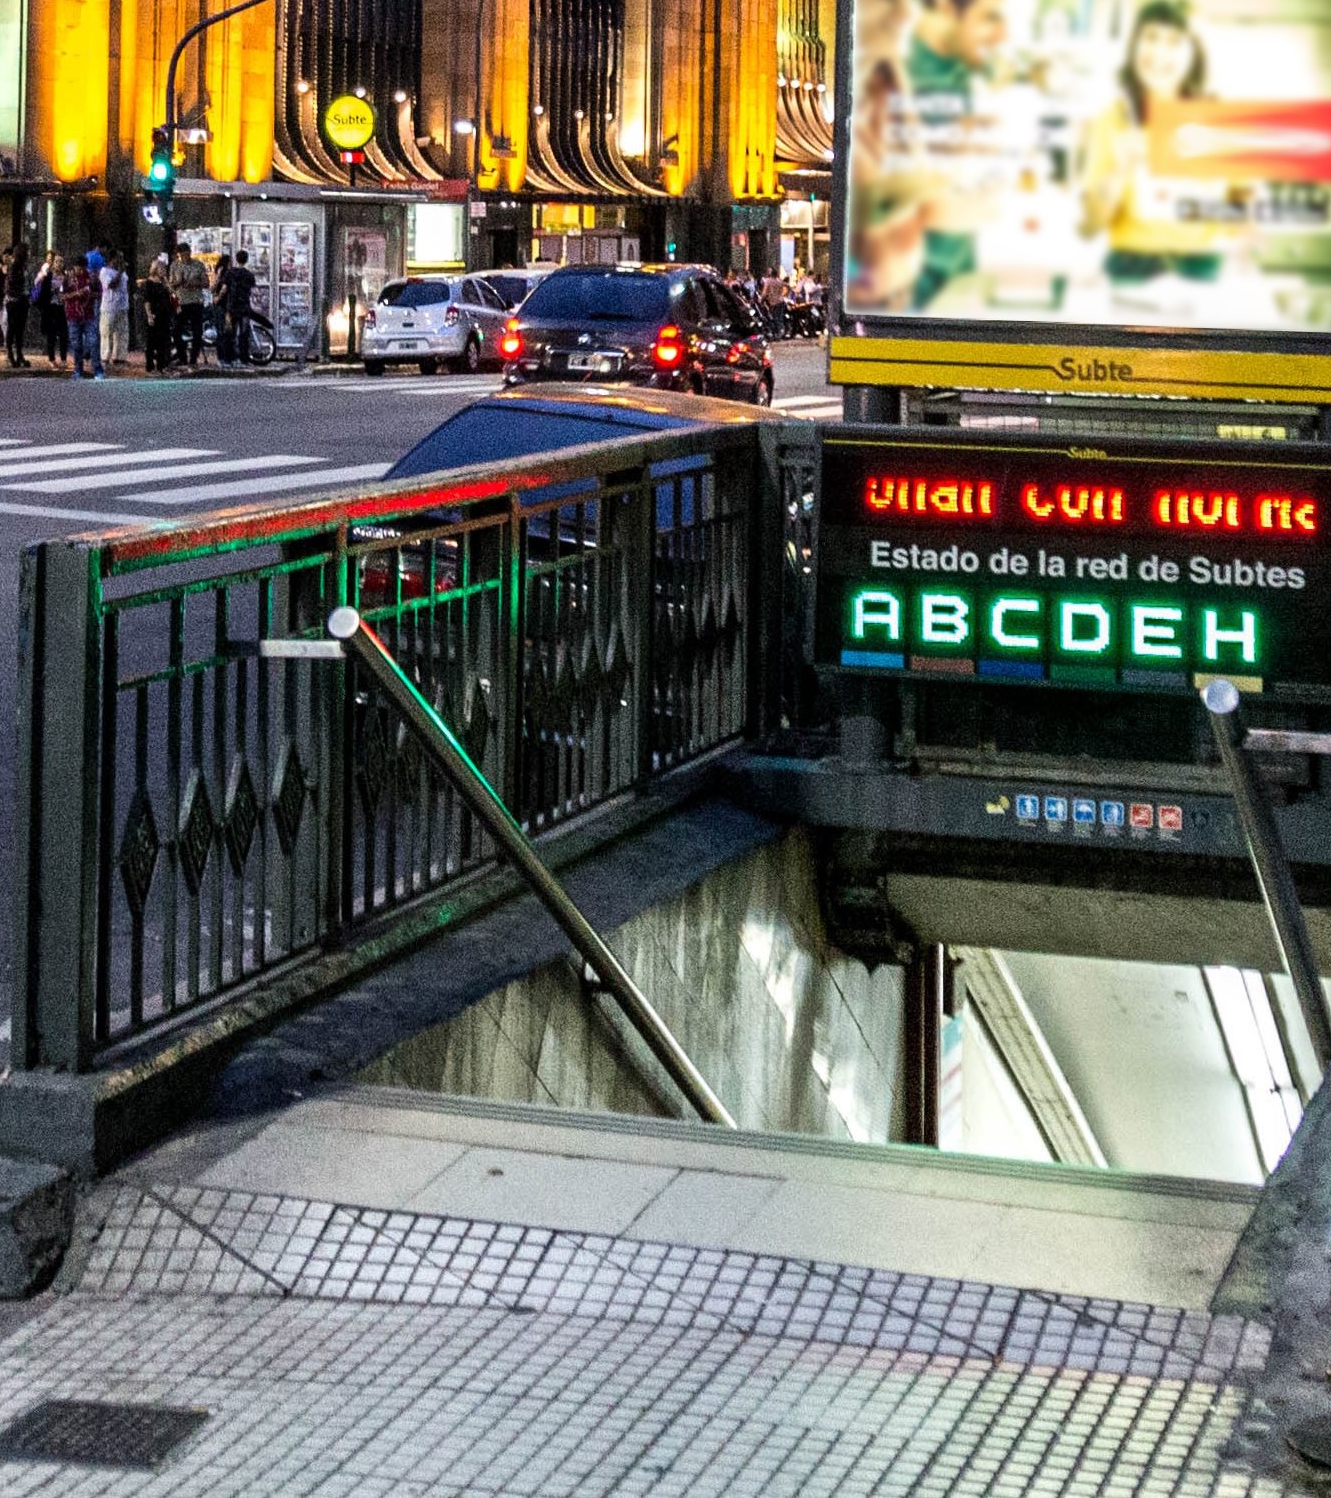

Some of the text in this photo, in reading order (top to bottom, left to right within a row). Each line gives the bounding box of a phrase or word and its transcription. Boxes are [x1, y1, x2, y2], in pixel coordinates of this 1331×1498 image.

[332, 113, 368, 125] Subte
[1058, 355, 1135, 383] Subte
[870, 539, 1307, 590] Estado de la red de Subtes
